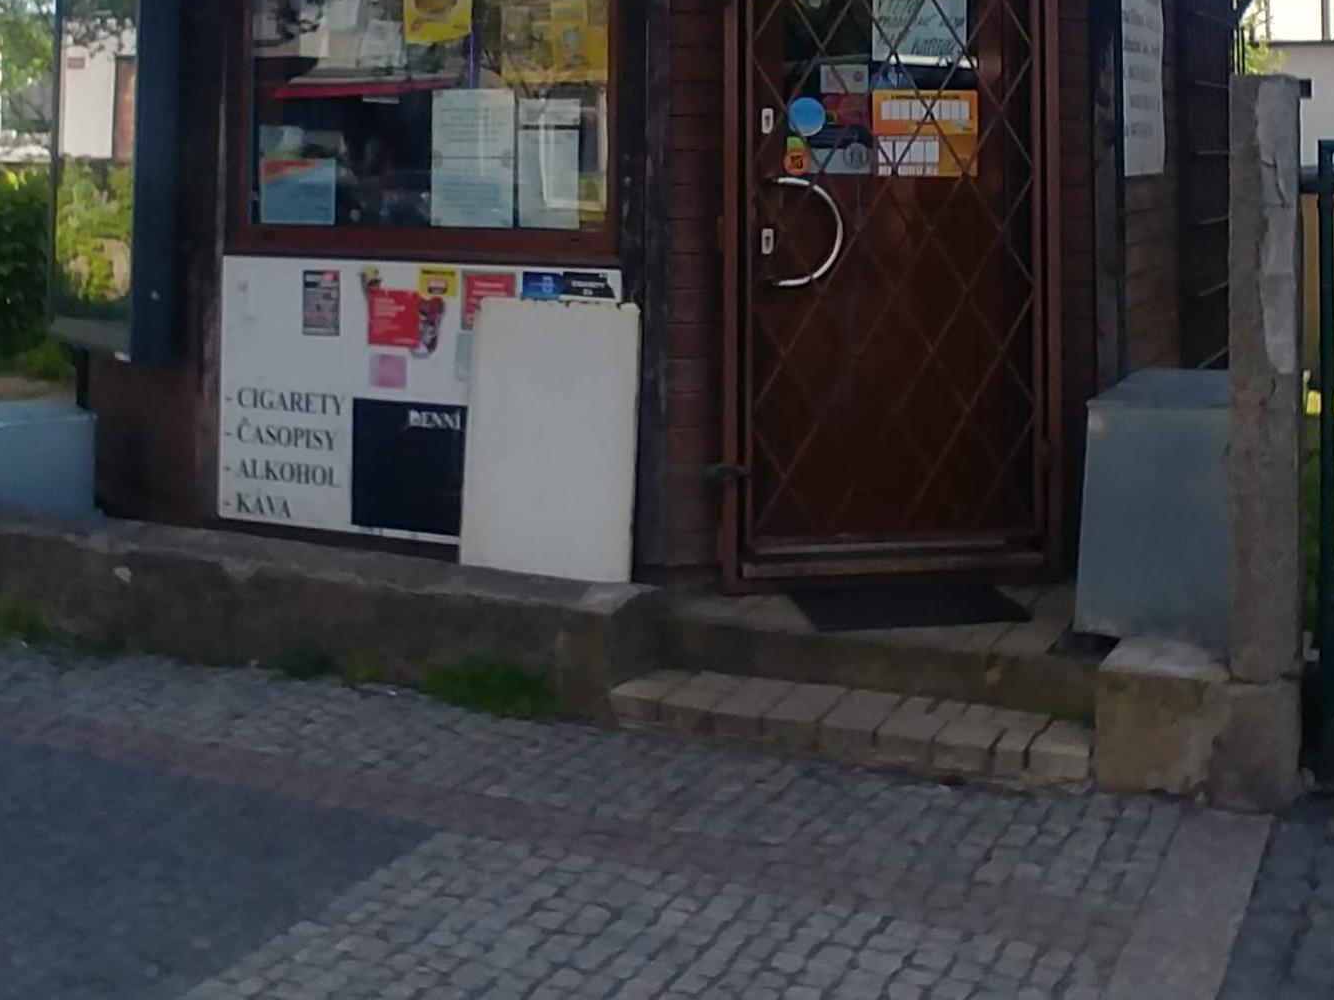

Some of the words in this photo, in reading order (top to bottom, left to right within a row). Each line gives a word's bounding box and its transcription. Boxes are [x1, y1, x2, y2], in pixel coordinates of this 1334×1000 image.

[238, 388, 344, 415] CIGARETY
[237, 417, 336, 451] ČASOPISY
[236, 457, 342, 488] ALKOHOL
[236, 488, 293, 518] KÁVA
